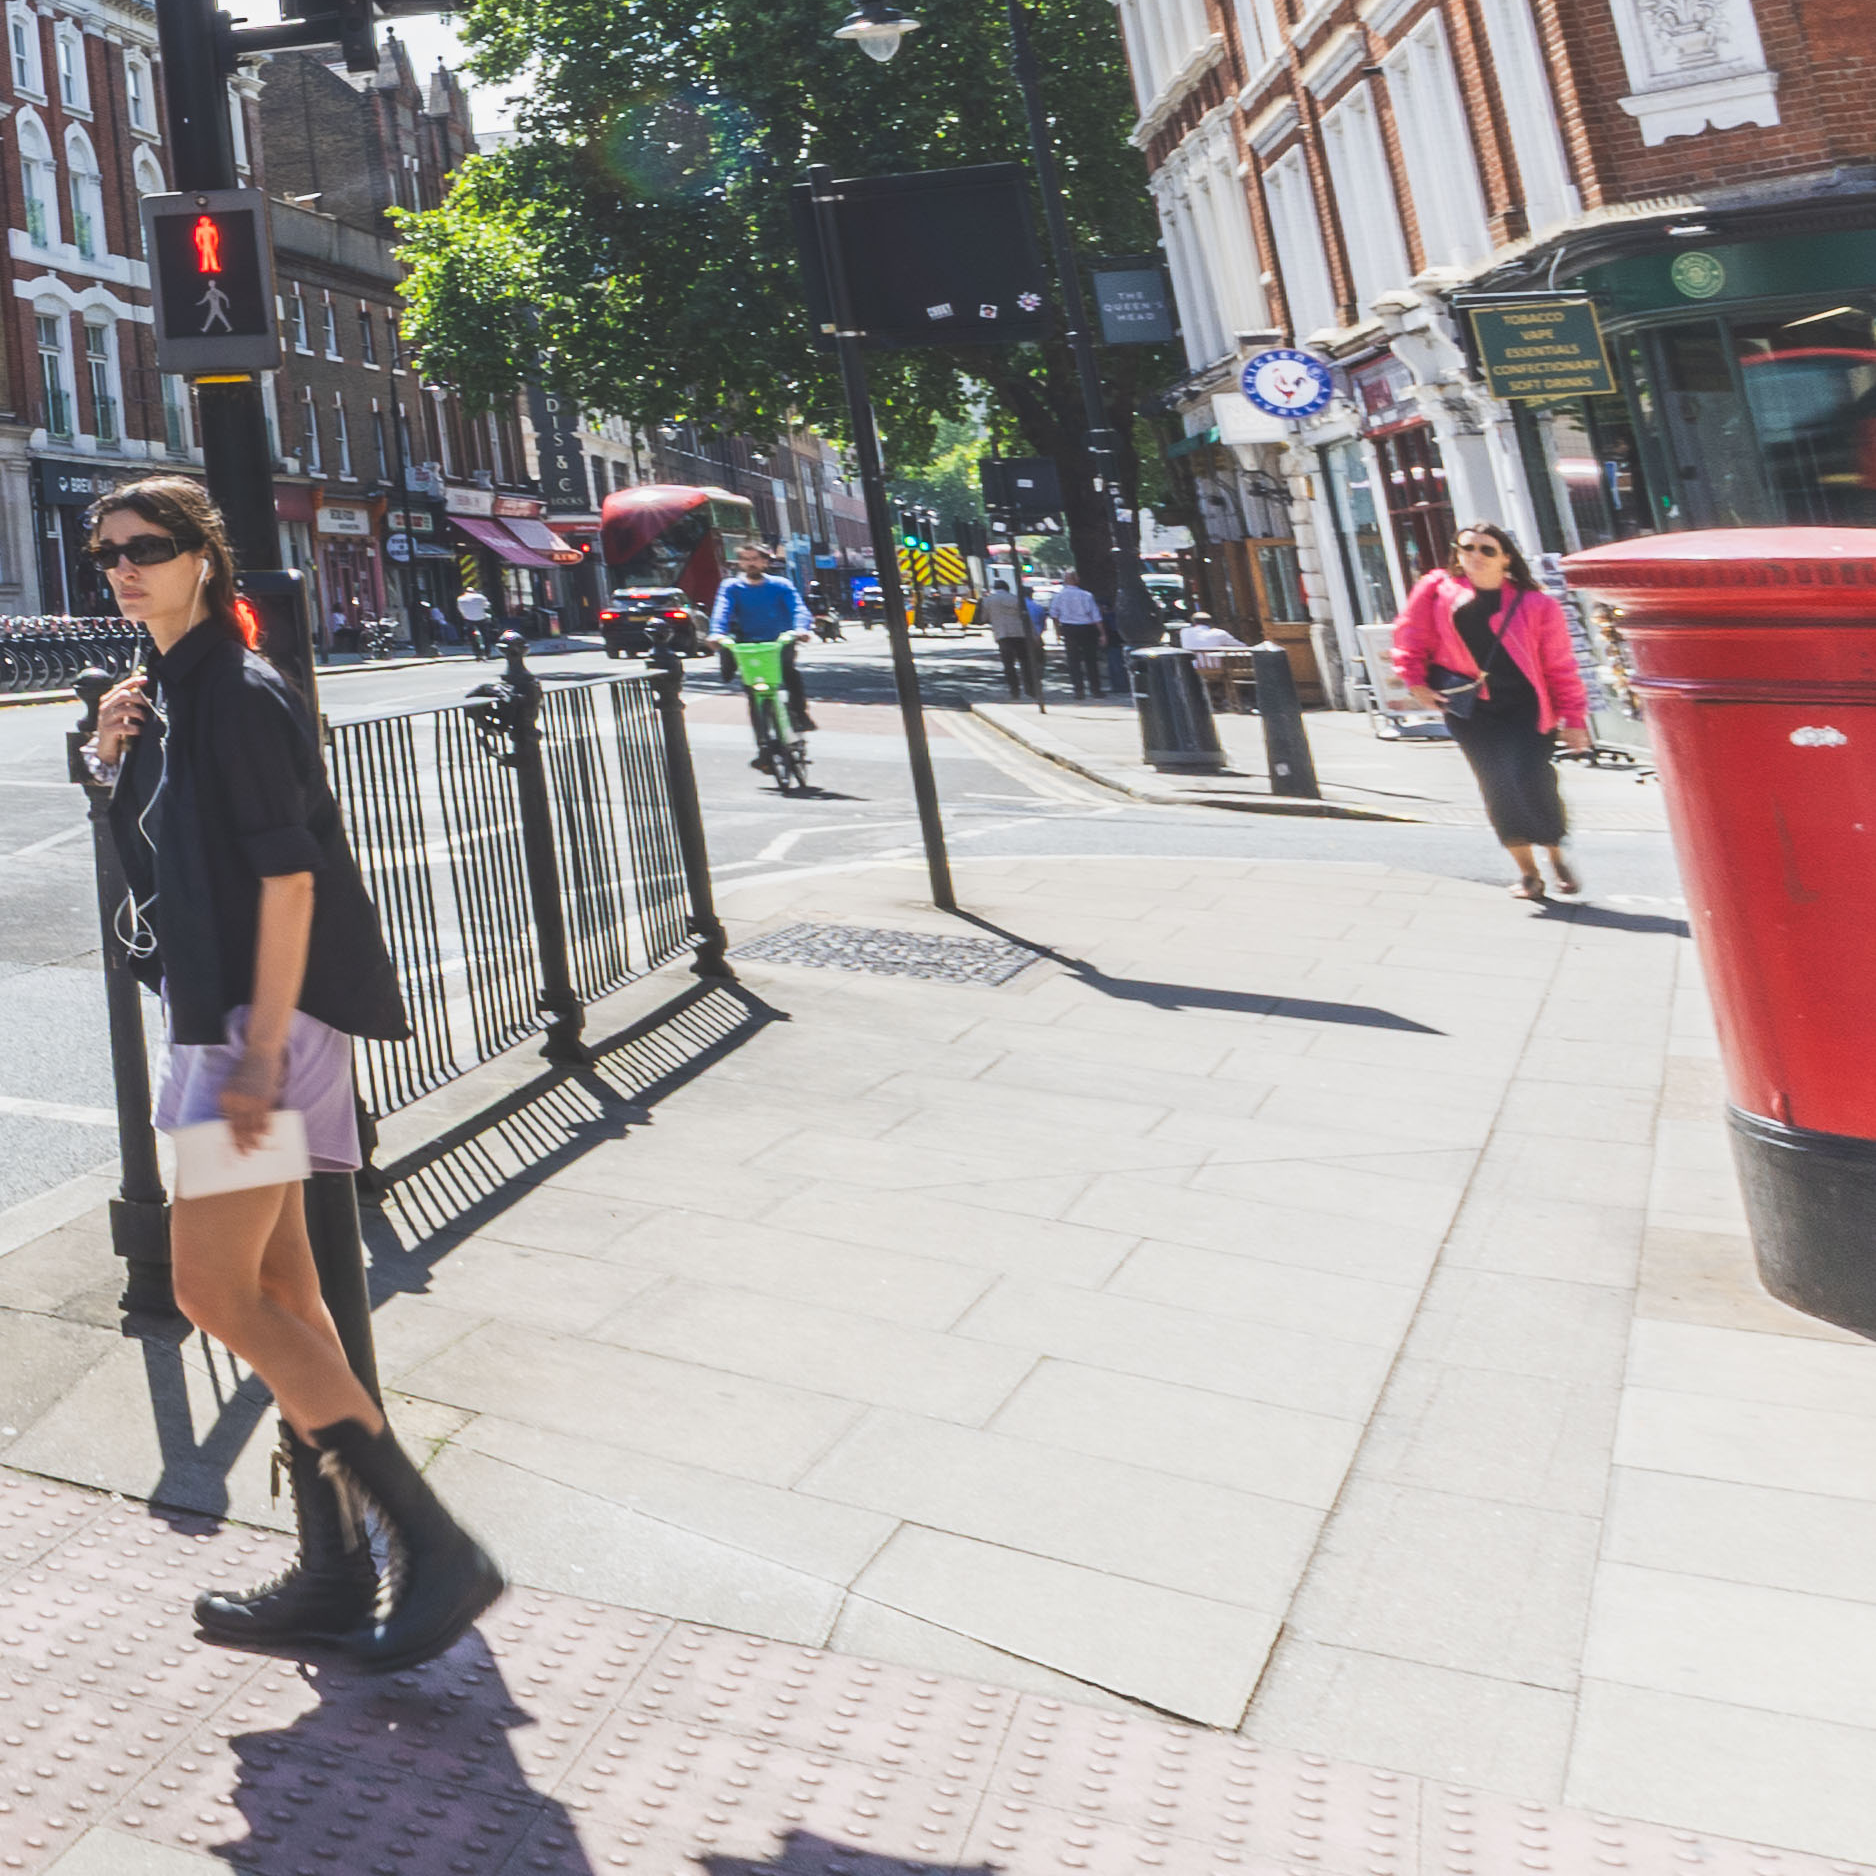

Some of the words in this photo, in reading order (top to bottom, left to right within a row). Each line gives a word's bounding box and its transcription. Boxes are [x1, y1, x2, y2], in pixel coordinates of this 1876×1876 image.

[1502, 312, 1564, 324] TOBACCO
[1244, 351, 1306, 395] CHICKEN
[1508, 379, 1540, 390] SOFT
[1544, 376, 1593, 389] DRINKS
